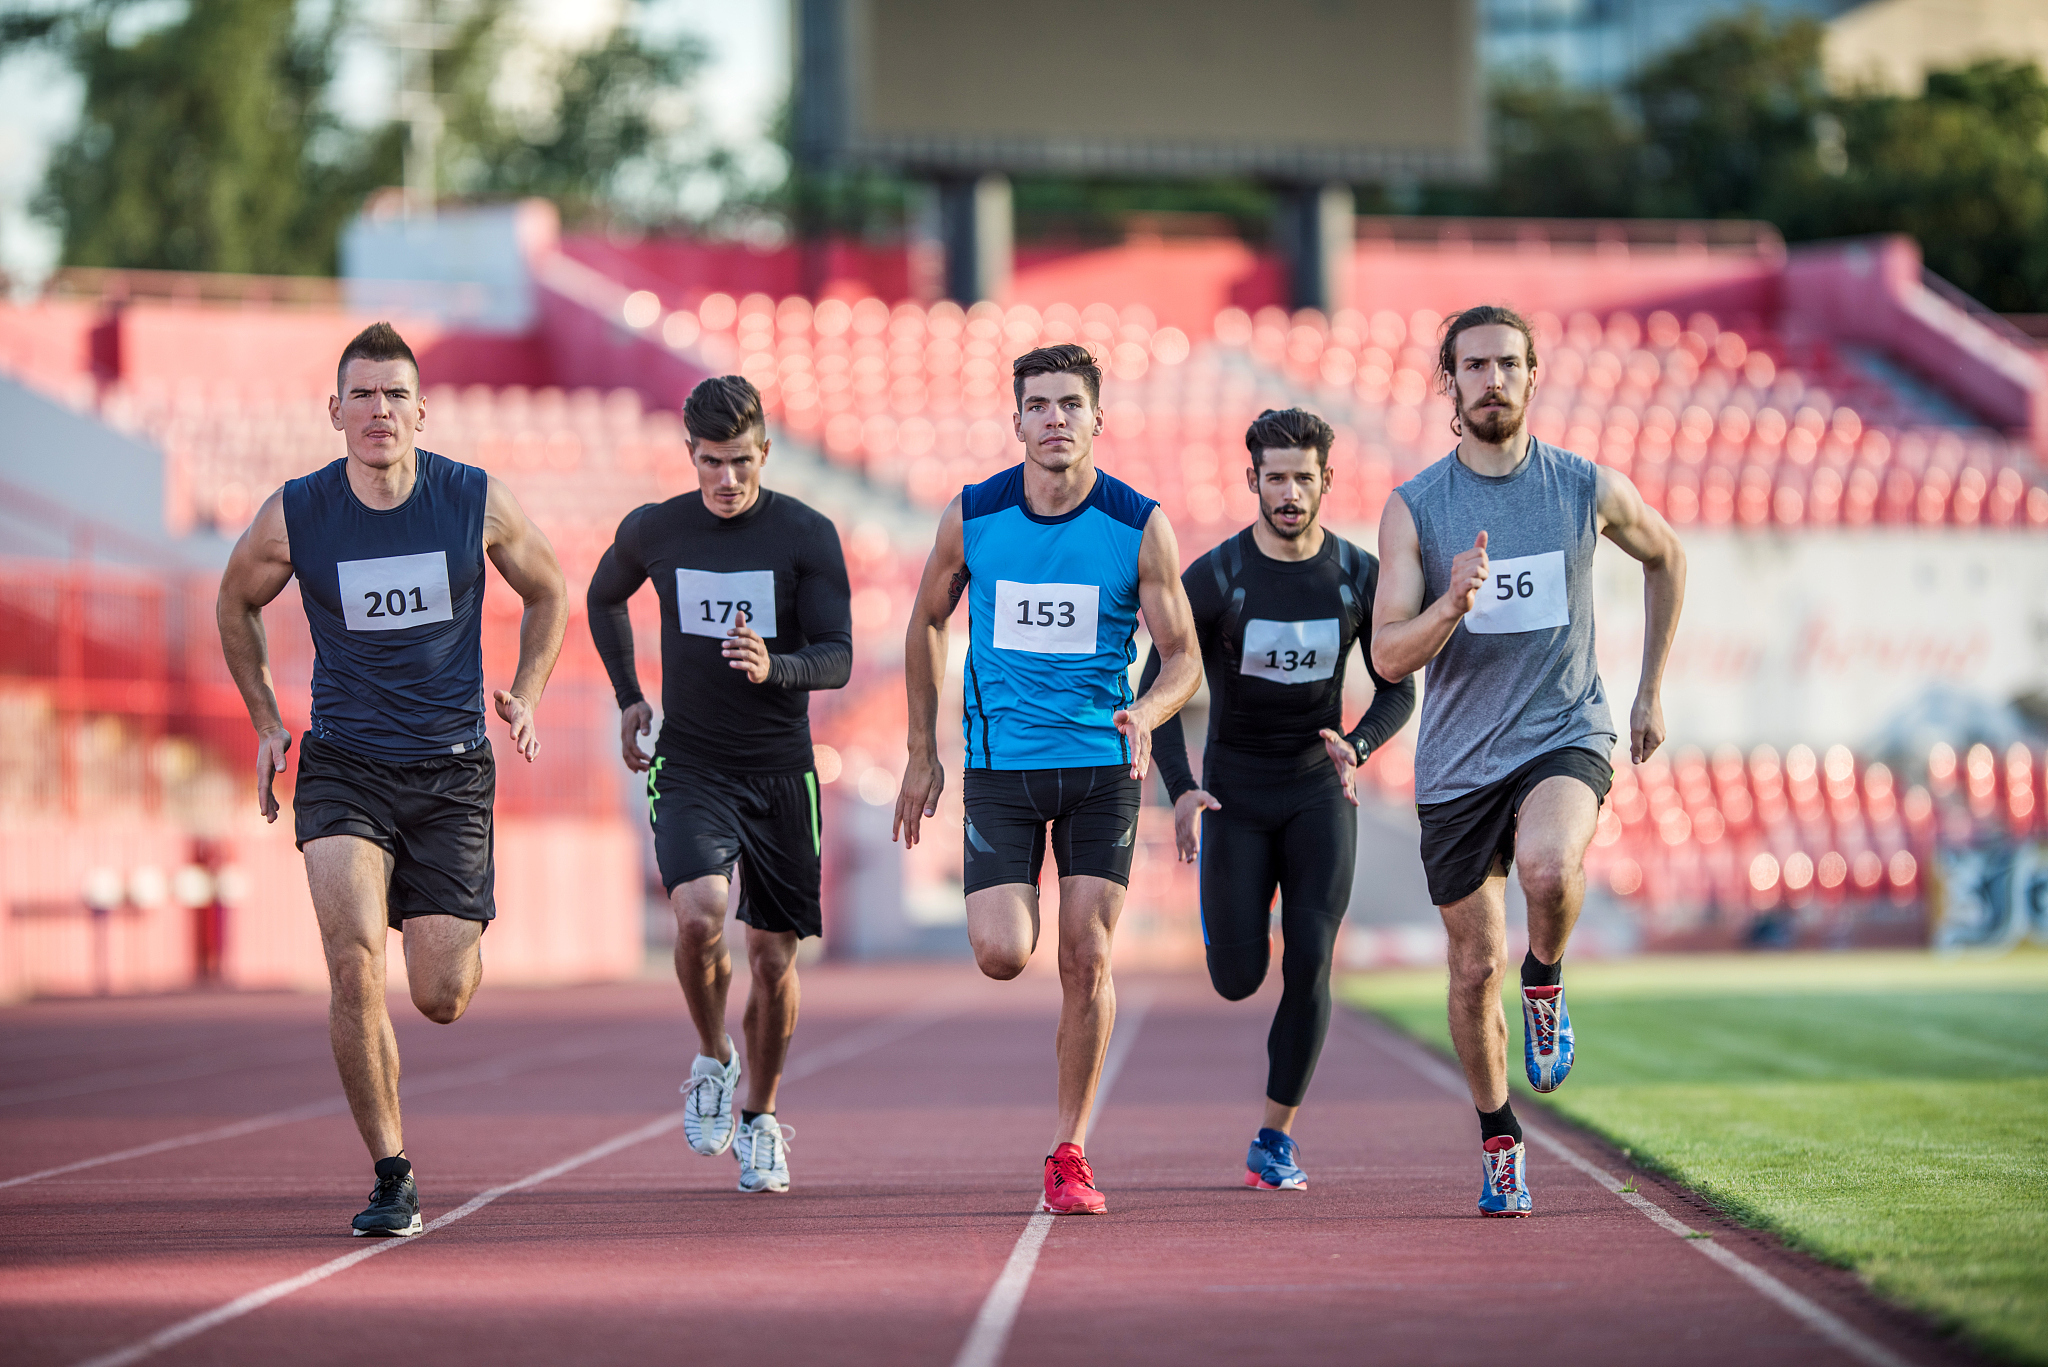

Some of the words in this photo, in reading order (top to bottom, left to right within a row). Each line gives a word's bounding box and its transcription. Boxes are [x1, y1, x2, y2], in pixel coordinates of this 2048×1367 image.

[1496, 571, 1534, 601] 56
[364, 586, 429, 618] 201
[699, 599, 754, 624] 178
[1017, 599, 1076, 628] 153
[1264, 649, 1318, 672] 134
